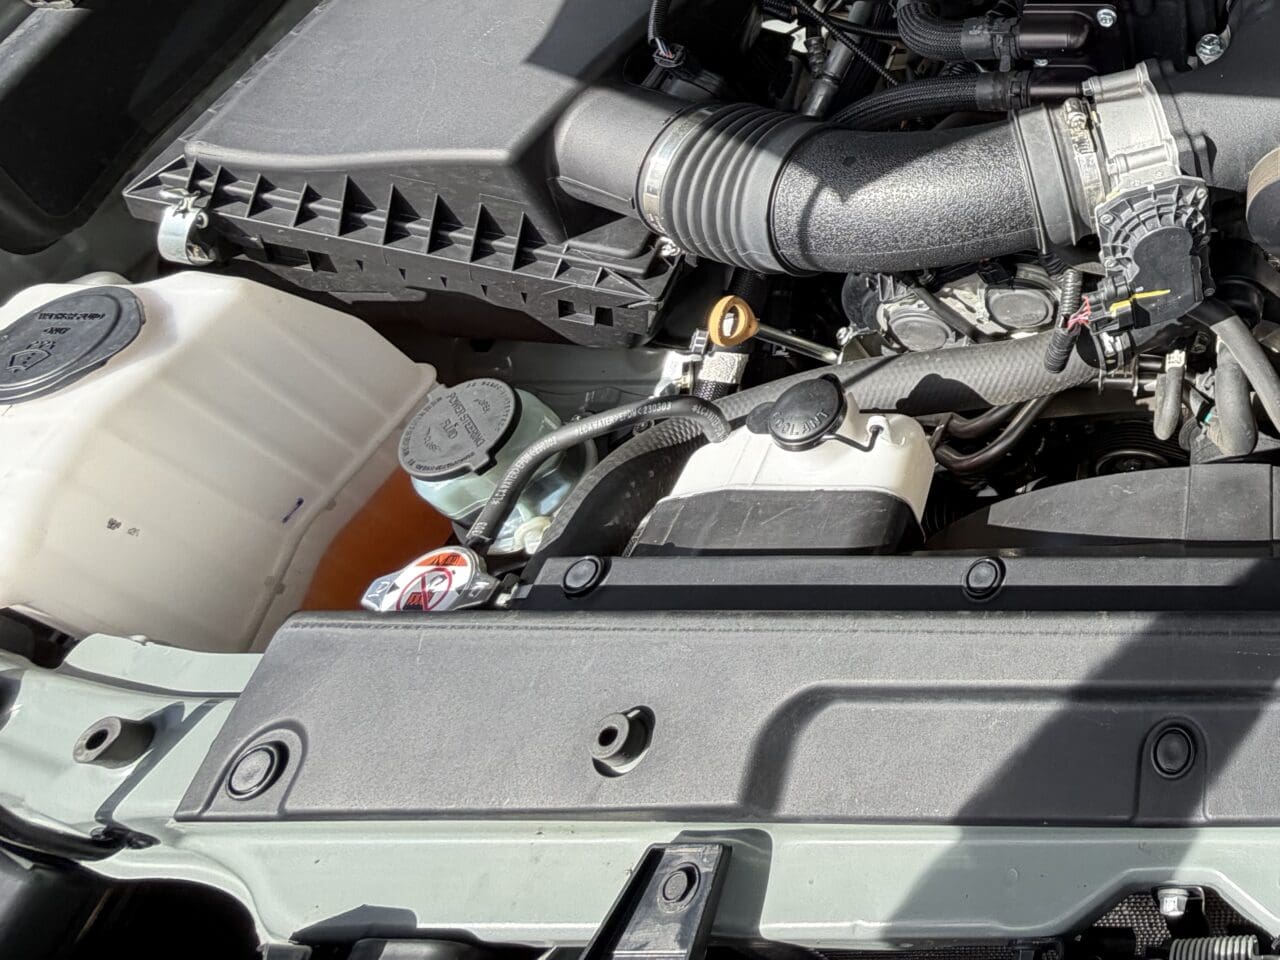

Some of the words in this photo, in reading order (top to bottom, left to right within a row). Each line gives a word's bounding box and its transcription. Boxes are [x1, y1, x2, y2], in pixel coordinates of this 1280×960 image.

[441, 418, 459, 440] FLUID
[447, 391, 466, 418] POWER
[460, 413, 486, 448] STEERING
[773, 410, 829, 436] COOLANT
